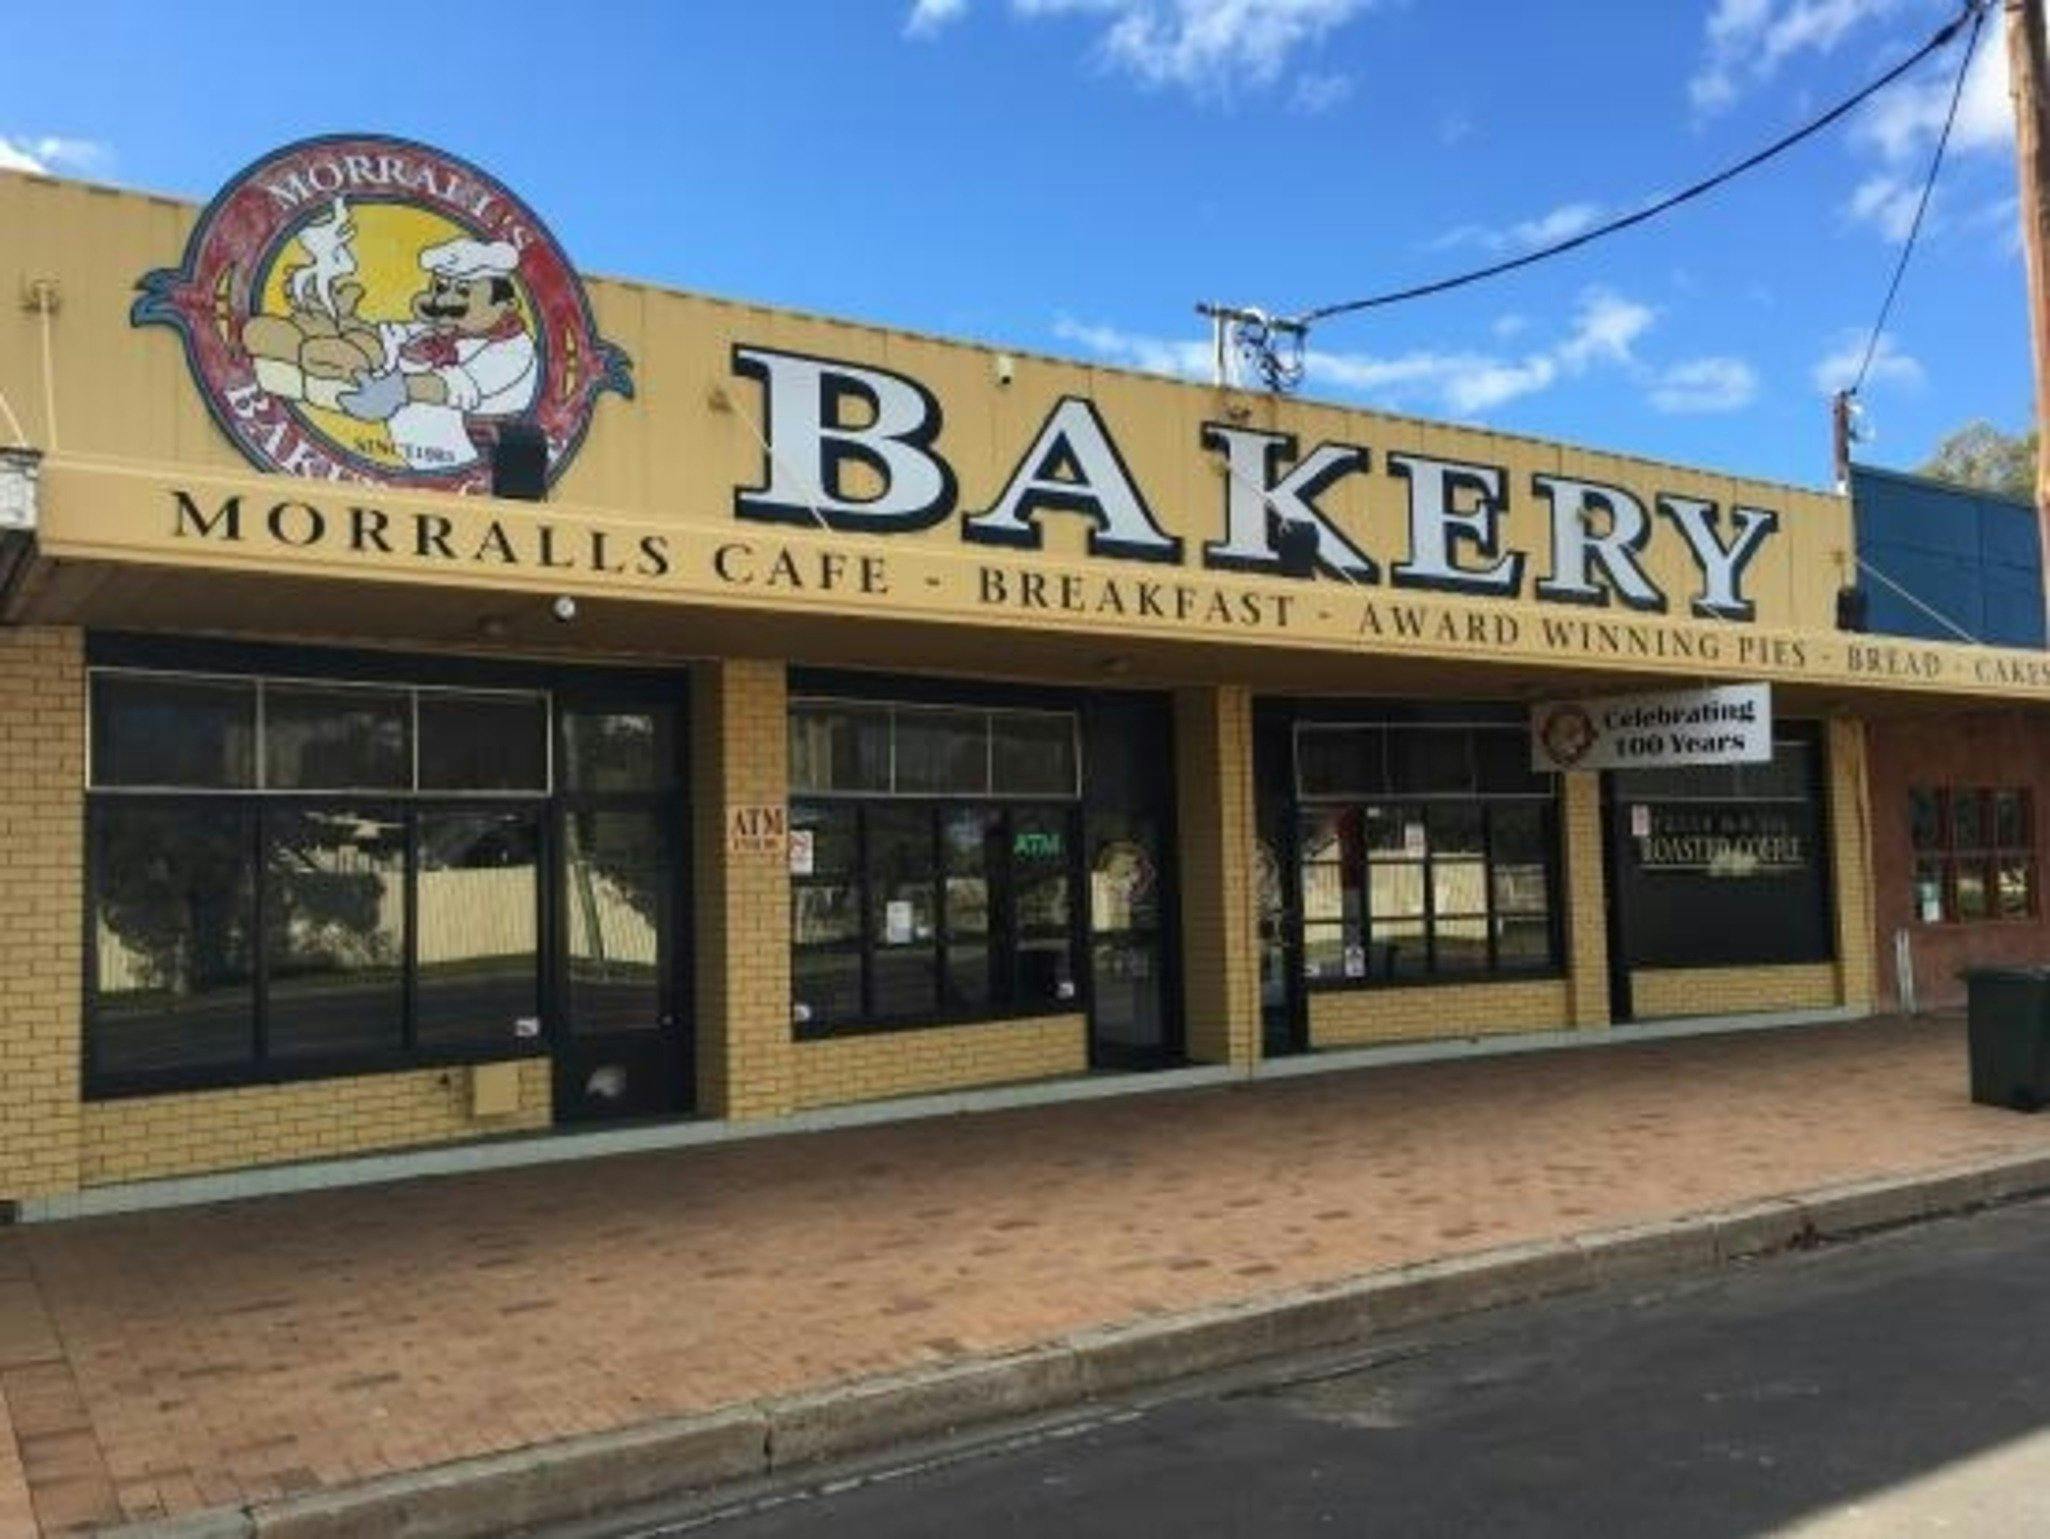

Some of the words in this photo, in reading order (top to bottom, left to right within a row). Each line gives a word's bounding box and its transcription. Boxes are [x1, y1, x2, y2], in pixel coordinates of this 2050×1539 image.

[732, 345, 1779, 621] BAKERY
[171, 490, 669, 577] MORRALLS
[713, 543, 890, 594] CAFE
[979, 565, 1294, 627] BREAKFAST
[1357, 602, 1520, 645] AWARD
[1542, 615, 1720, 659] WINNING
[1738, 635, 1806, 667] PIES
[1847, 644, 1941, 678] BREAD
[1603, 700, 1757, 732] Celebrating
[1616, 737, 1665, 758] 100
[1669, 731, 1746, 755] Years
[732, 806, 784, 836] ATM
[1012, 832, 1062, 856] ATM
